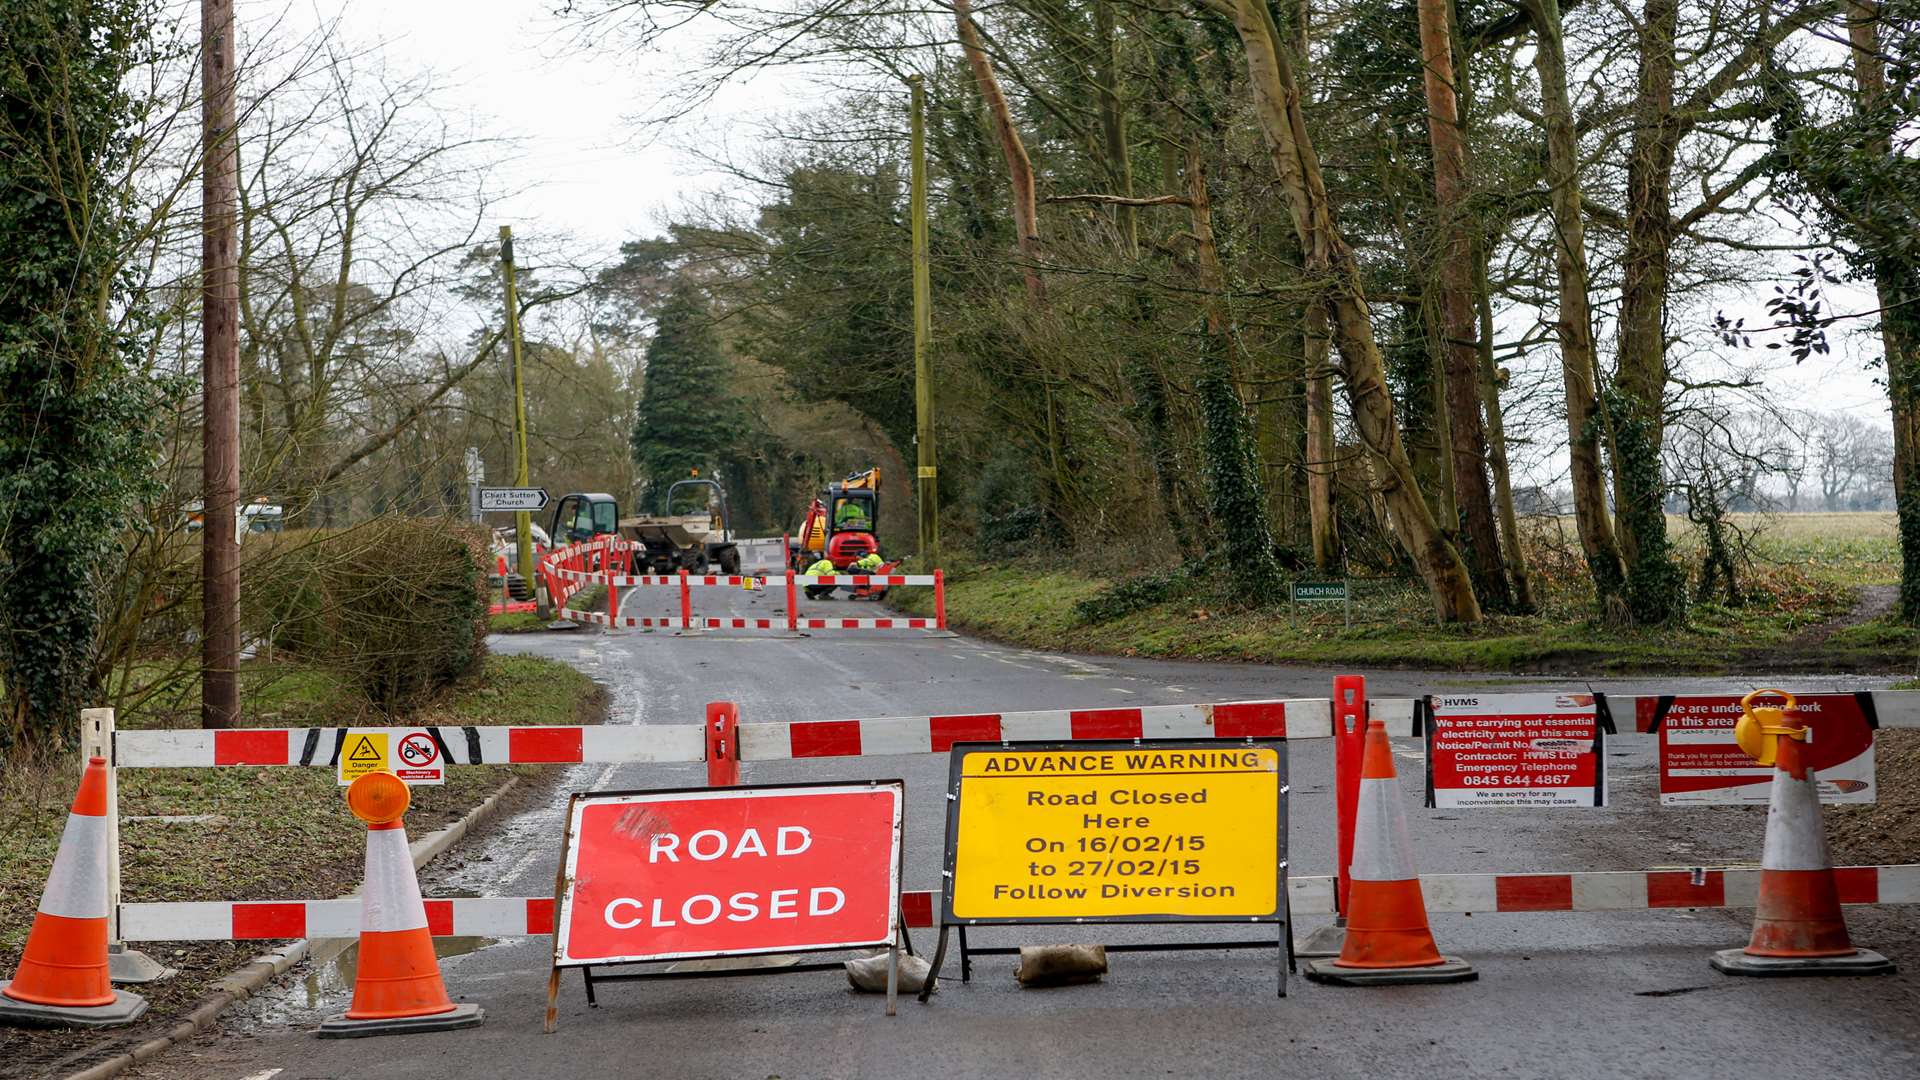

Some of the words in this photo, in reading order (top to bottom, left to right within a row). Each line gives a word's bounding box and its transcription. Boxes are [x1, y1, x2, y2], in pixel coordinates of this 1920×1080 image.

[1297, 587, 1324, 595] CHURCH
[1326, 587, 1344, 595] ROAD
[1444, 698, 1478, 706] HVMS
[1668, 704, 1685, 713] We
[1436, 719, 1453, 728] We
[1456, 720, 1474, 728] are
[1476, 718, 1521, 729] carrying
[1524, 718, 1542, 726] out
[1545, 717, 1594, 726] essential
[1666, 716, 1678, 726] in
[1682, 716, 1704, 726] this
[1707, 718, 1734, 726] area
[1442, 730, 1496, 740] electricity
[1498, 729, 1527, 738] work
[1528, 729, 1538, 737] in
[1541, 728, 1563, 737] this
[1436, 740, 1510, 750] Notice/Permit
[1454, 752, 1517, 760] Contractor:
[1523, 751, 1556, 759] HVMS
[984, 755, 1114, 773] ADVANCE
[1126, 753, 1260, 770] WARNING
[1456, 763, 1518, 774] Emergency
[1520, 763, 1577, 772] Telephone
[1464, 776, 1500, 786] 0845
[1504, 775, 1531, 786] 644
[1534, 775, 1570, 784] 4867
[1027, 790, 1098, 806] Road
[1110, 788, 1208, 805] Closed
[1082, 814, 1151, 829] Here
[649, 826, 812, 863] ROAD
[1026, 838, 1065, 853] On
[1078, 835, 1206, 854] 16/02/15
[1029, 861, 1056, 876] to
[1068, 859, 1201, 877] 27/02/15
[993, 884, 1087, 900] Follow
[1101, 883, 1235, 899] Diversion
[604, 886, 846, 929] CLOSED
